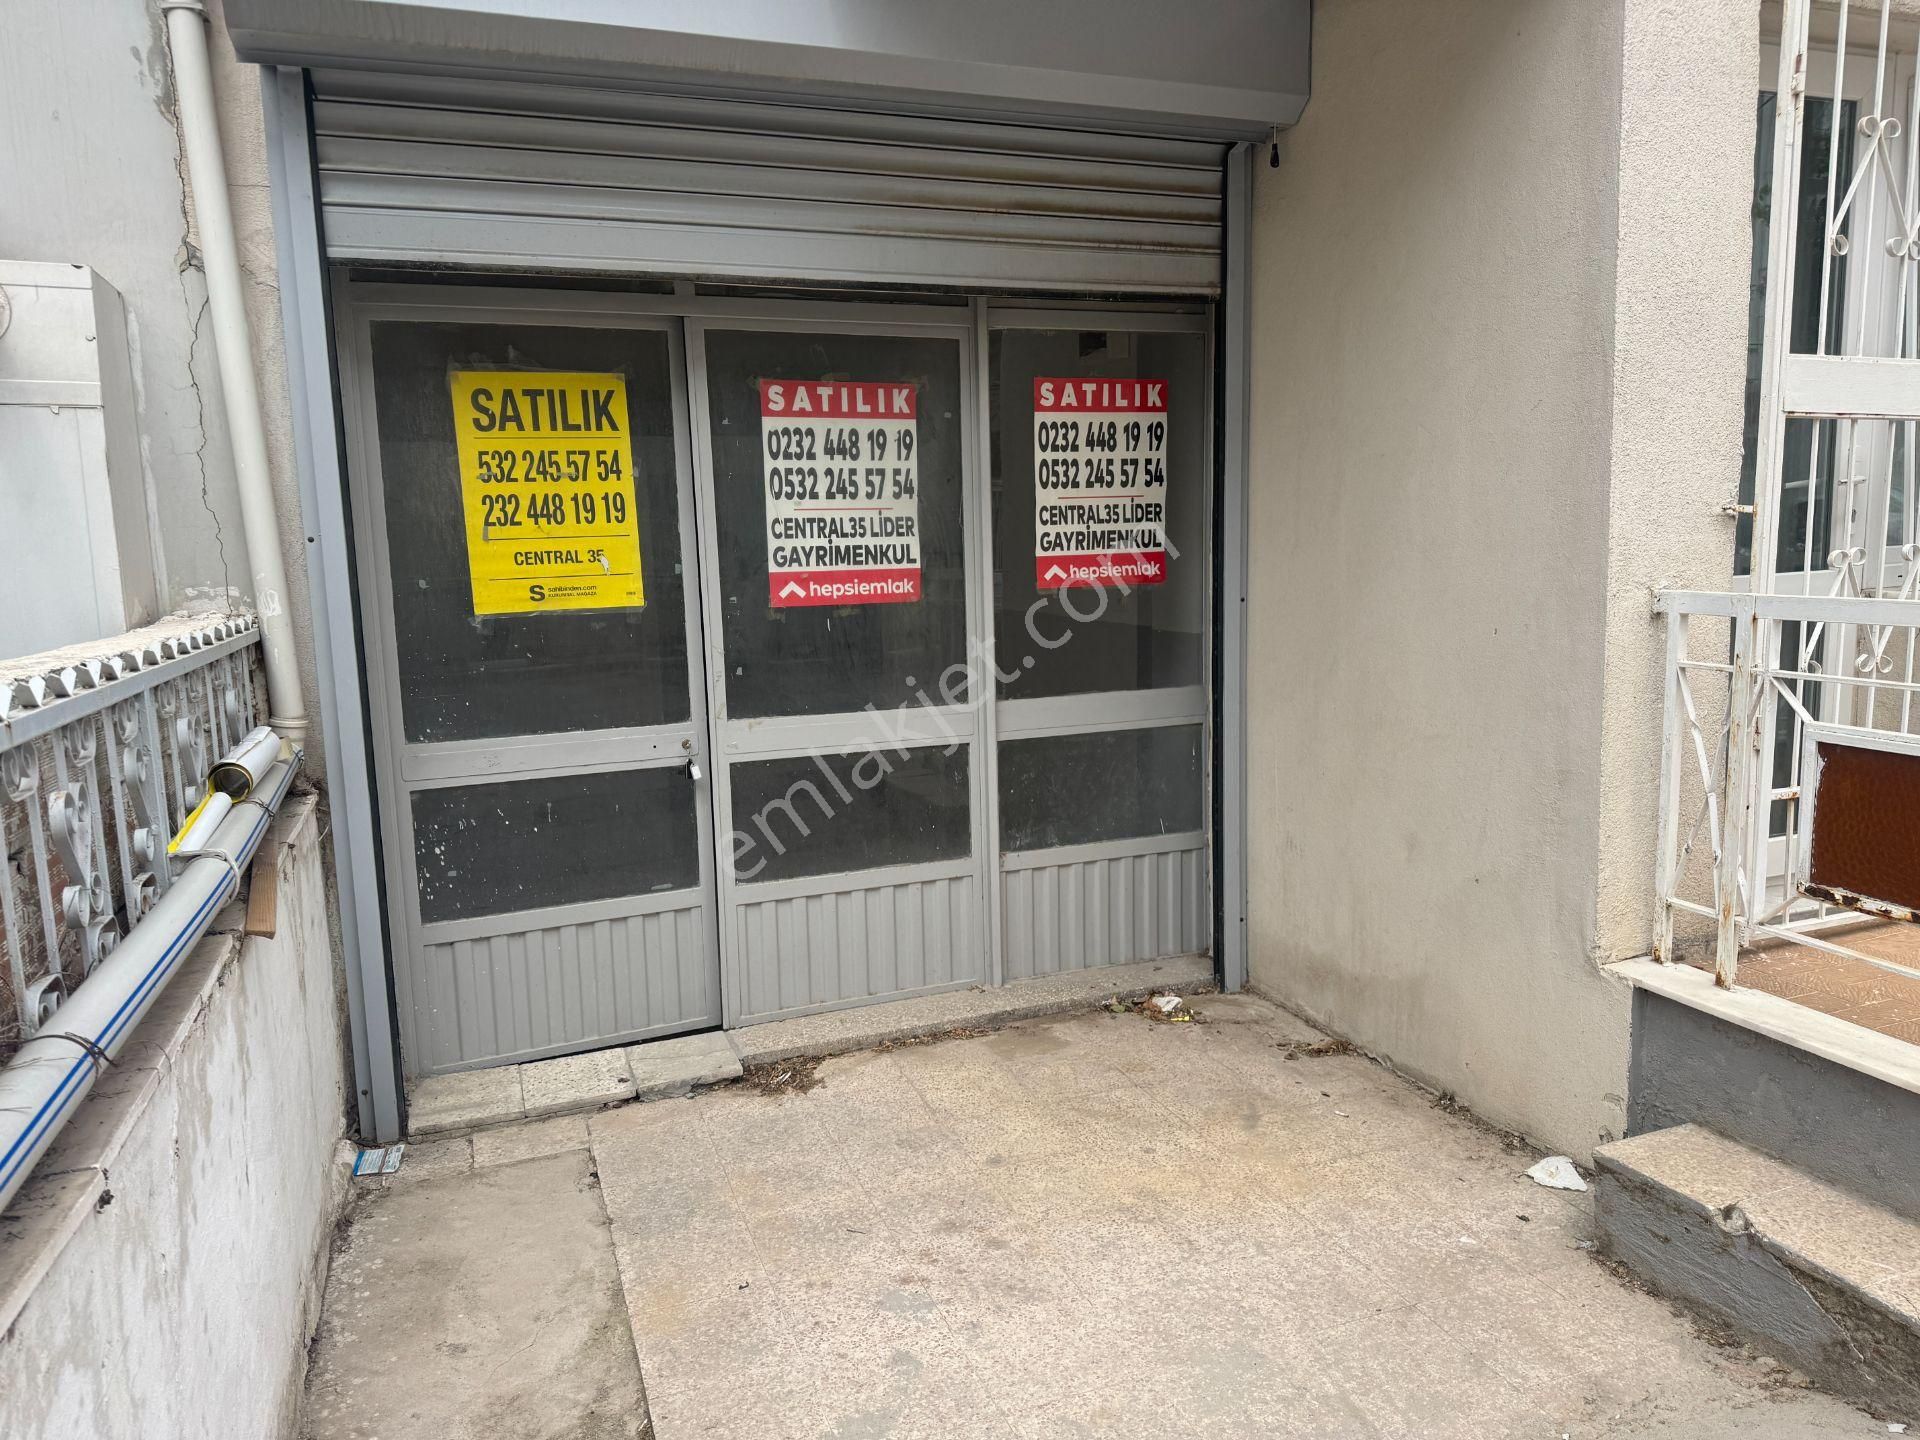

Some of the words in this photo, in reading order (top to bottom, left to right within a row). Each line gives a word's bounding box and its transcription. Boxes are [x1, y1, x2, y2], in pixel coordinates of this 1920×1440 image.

[470, 387, 620, 432] SATILIK
[767, 384, 911, 414] SATILIK
[1039, 382, 1163, 408] SATILIK
[767, 427, 817, 461] 0232
[823, 428, 861, 461] 448
[867, 428, 887, 461] 19
[895, 428, 914, 461] 19
[1038, 421, 1079, 453] 0232
[1085, 421, 1117, 452] 448
[1123, 421, 1141, 452] 19
[1146, 421, 1165, 452] 19
[477, 450, 518, 483] 532
[522, 450, 562, 482] 245
[566, 450, 590, 482] 57
[596, 449, 622, 482] 54
[1038, 458, 1080, 490] 0532
[1085, 458, 1115, 489] 245
[1120, 458, 1139, 488] 57
[1144, 457, 1165, 487] 54
[769, 467, 819, 501] 0532
[823, 467, 859, 500] 245
[865, 467, 886, 500] 57
[892, 467, 915, 500] 54
[481, 494, 522, 527] 232
[527, 493, 566, 526] 448
[571, 492, 596, 525] 19
[601, 491, 626, 524] 19
[1039, 503, 1120, 527] CENTRAL35
[1122, 497, 1162, 523] LİDER
[771, 516, 867, 540] CENTRAL35
[870, 510, 915, 537] LİDER
[1040, 525, 1162, 552] GAYRİMENKUL
[513, 550, 583, 566] CENTRAL
[587, 549, 604, 564] 35
[772, 538, 917, 567] GAYRİMENKUL
[1069, 561, 1161, 581] hepsiemlak
[547, 585, 597, 593] sahibinden.com
[809, 578, 914, 599] hepsiemlak
